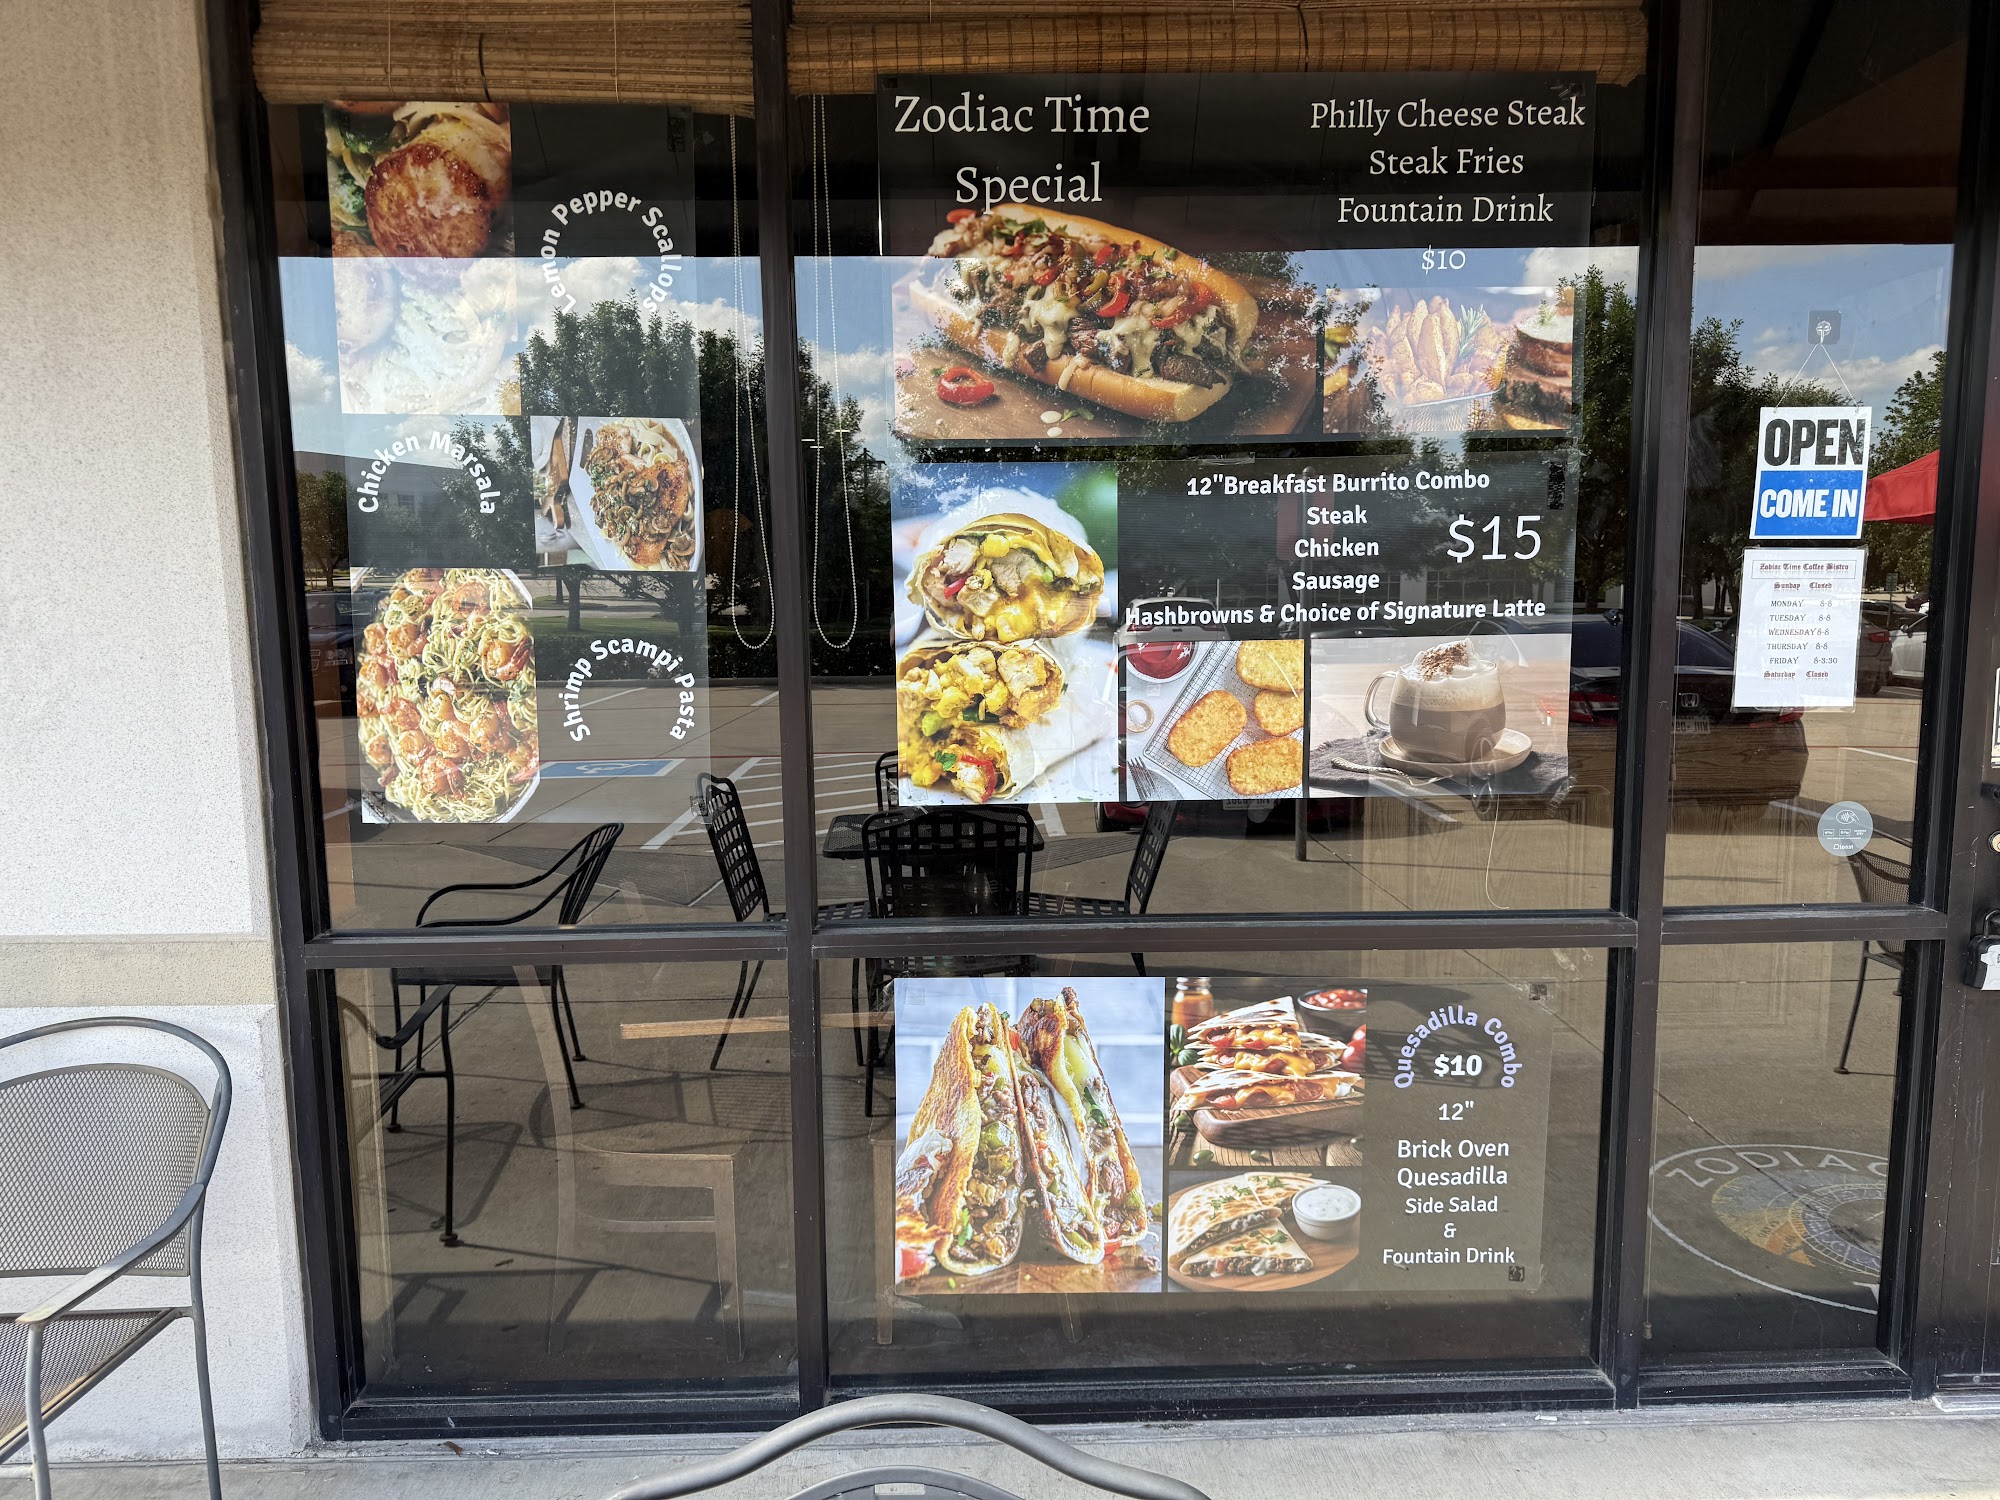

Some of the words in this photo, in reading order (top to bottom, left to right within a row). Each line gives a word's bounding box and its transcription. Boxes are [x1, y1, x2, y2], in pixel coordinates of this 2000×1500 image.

[894, 91, 1034, 133] Zodiac
[1044, 93, 1150, 133] Time
[1310, 98, 1391, 136] Philly
[1397, 98, 1499, 128] Cheese
[1507, 96, 1586, 126] Steak
[1369, 146, 1448, 175] Steak
[1456, 147, 1524, 174] Fries
[955, 161, 1103, 215] Special
[551, 189, 642, 226] Pepper
[1337, 195, 1464, 223] Fountain
[1471, 193, 1554, 222] Drink
[540, 228, 577, 315] Lemon
[641, 206, 682, 313] Scallops
[1421, 244, 1466, 275] $10
[1764, 418, 1866, 466] OPEN
[356, 434, 421, 513] Chicken
[428, 430, 501, 514] Marsala
[1186, 473, 1327, 497] 12"Breakfast
[1333, 472, 1409, 493] Burrito
[1414, 469, 1490, 491] Combo
[1306, 504, 1368, 526] Steak
[1760, 488, 1829, 518] COME
[1831, 489, 1858, 518] IN
[1294, 538, 1380, 558] Chicken
[1446, 513, 1542, 564] $15
[1759, 563, 1781, 571] Zodiac
[1783, 563, 1801, 571] Time
[1802, 563, 1824, 571] Coffee
[1826, 563, 1849, 571] Bistro
[1292, 571, 1380, 595] Sausage
[1773, 582, 1801, 591] Sunday
[1809, 581, 1832, 589] Closed
[1125, 604, 1254, 627] Hashbrowns
[1259, 605, 1275, 624] &
[1280, 601, 1351, 623] Choice
[1356, 602, 1379, 622] of
[1383, 600, 1487, 625] Signature
[1491, 599, 1546, 619] Latte
[1770, 600, 1804, 608] MONDAY
[1769, 614, 1806, 622] TUESDAY
[1768, 628, 1816, 636] WEDNESDAY
[1767, 642, 1808, 650] THURSDAY
[1769, 656, 1799, 664] FRIDAY
[1763, 670, 1796, 680] Saturday
[1806, 670, 1829, 678] Closed
[558, 657, 593, 742] Shrimp
[590, 638, 684, 673] Scampi
[669, 672, 696, 740] Pasta
[1394, 1005, 1478, 1089] Quesadilla
[1484, 1017, 1523, 1088] Combo
[1433, 1053, 1483, 1078] $10
[1438, 1101, 1475, 1121] 12"
[1397, 1139, 1452, 1158] Brick
[1458, 1139, 1510, 1158] Oven
[1397, 1165, 1508, 1188] Quesadilla
[1405, 1197, 1444, 1214] Side
[1448, 1196, 1498, 1213] Salad
[1443, 1222, 1457, 1238] &
[1383, 1247, 1461, 1265] Fountain
[1466, 1246, 1515, 1264] Drink
